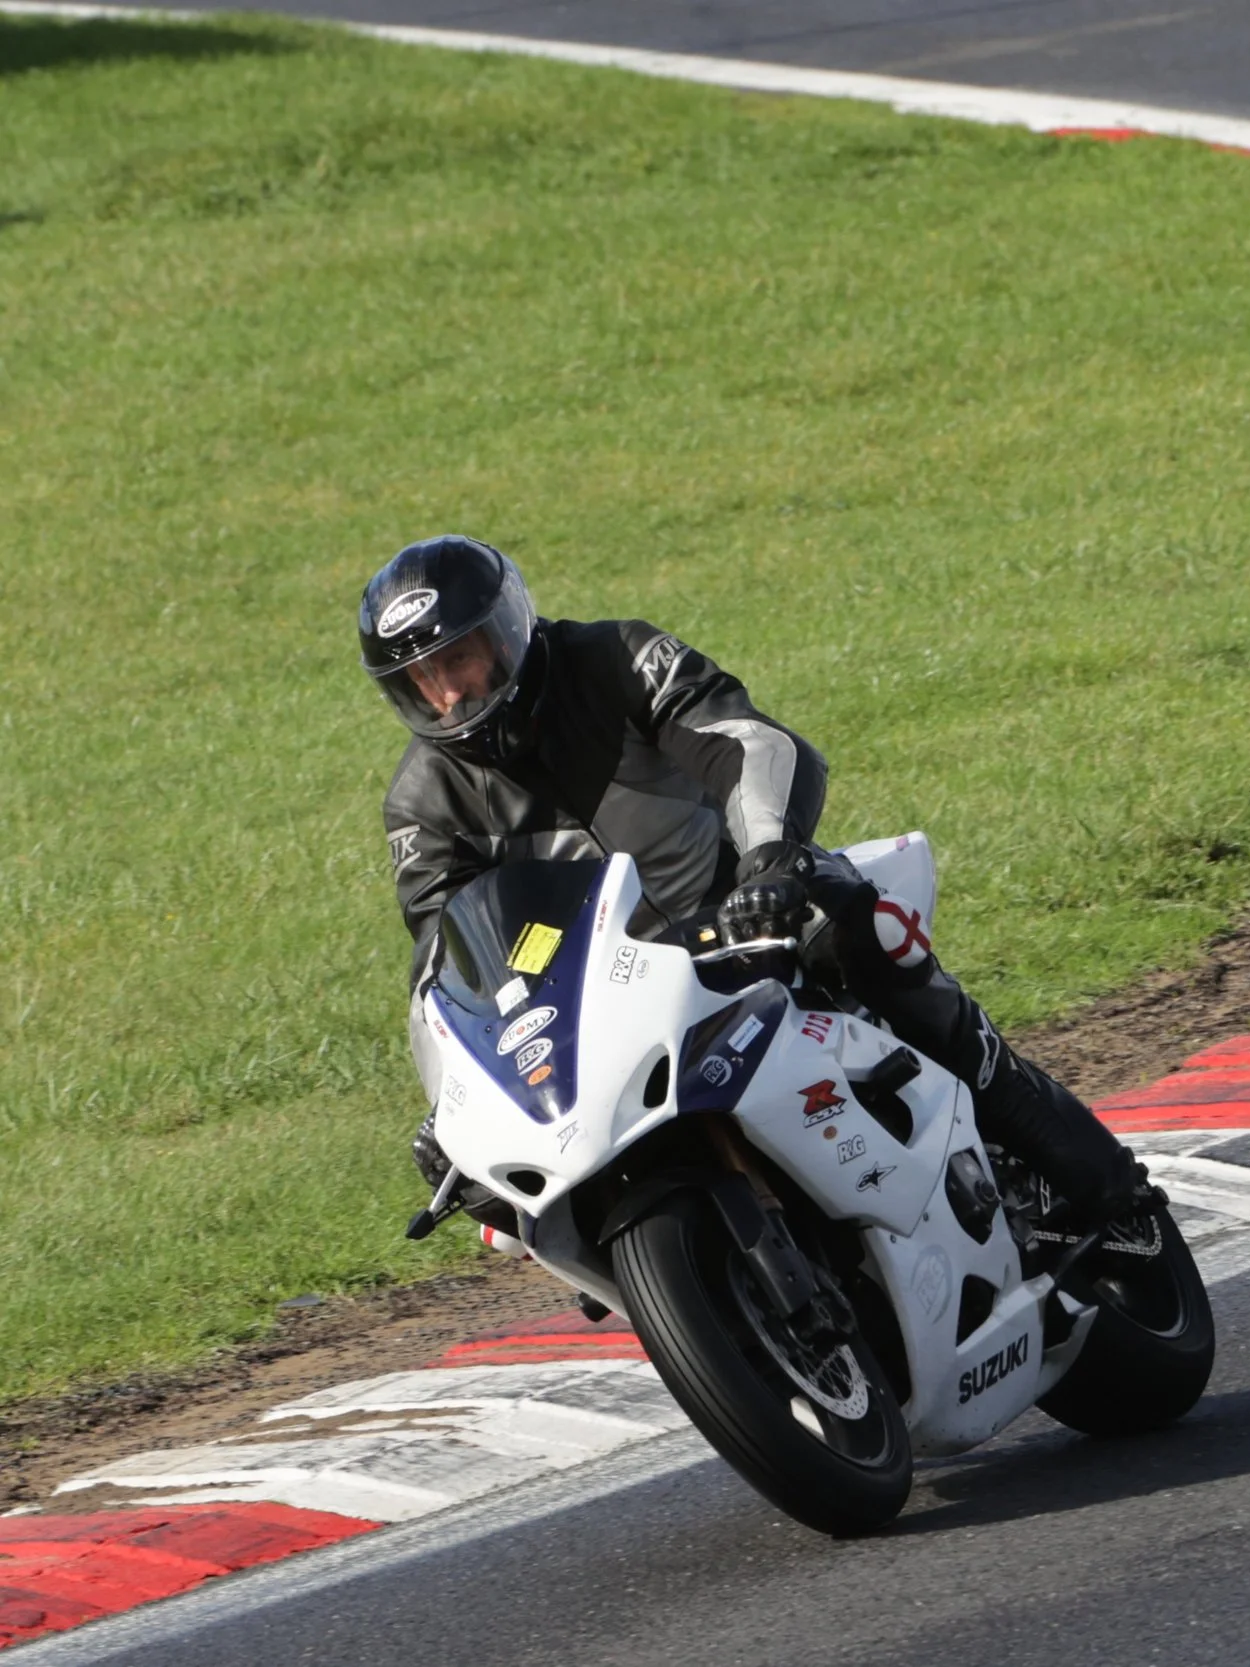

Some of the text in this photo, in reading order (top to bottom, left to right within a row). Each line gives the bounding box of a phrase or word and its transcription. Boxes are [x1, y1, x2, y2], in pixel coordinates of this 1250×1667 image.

[380, 594, 434, 632] SUOMY
[609, 945, 638, 985] R&G
[502, 1014, 549, 1046] SUOMY
[837, 1133, 866, 1165] R&G
[958, 1332, 1029, 1405] SUZUKI
